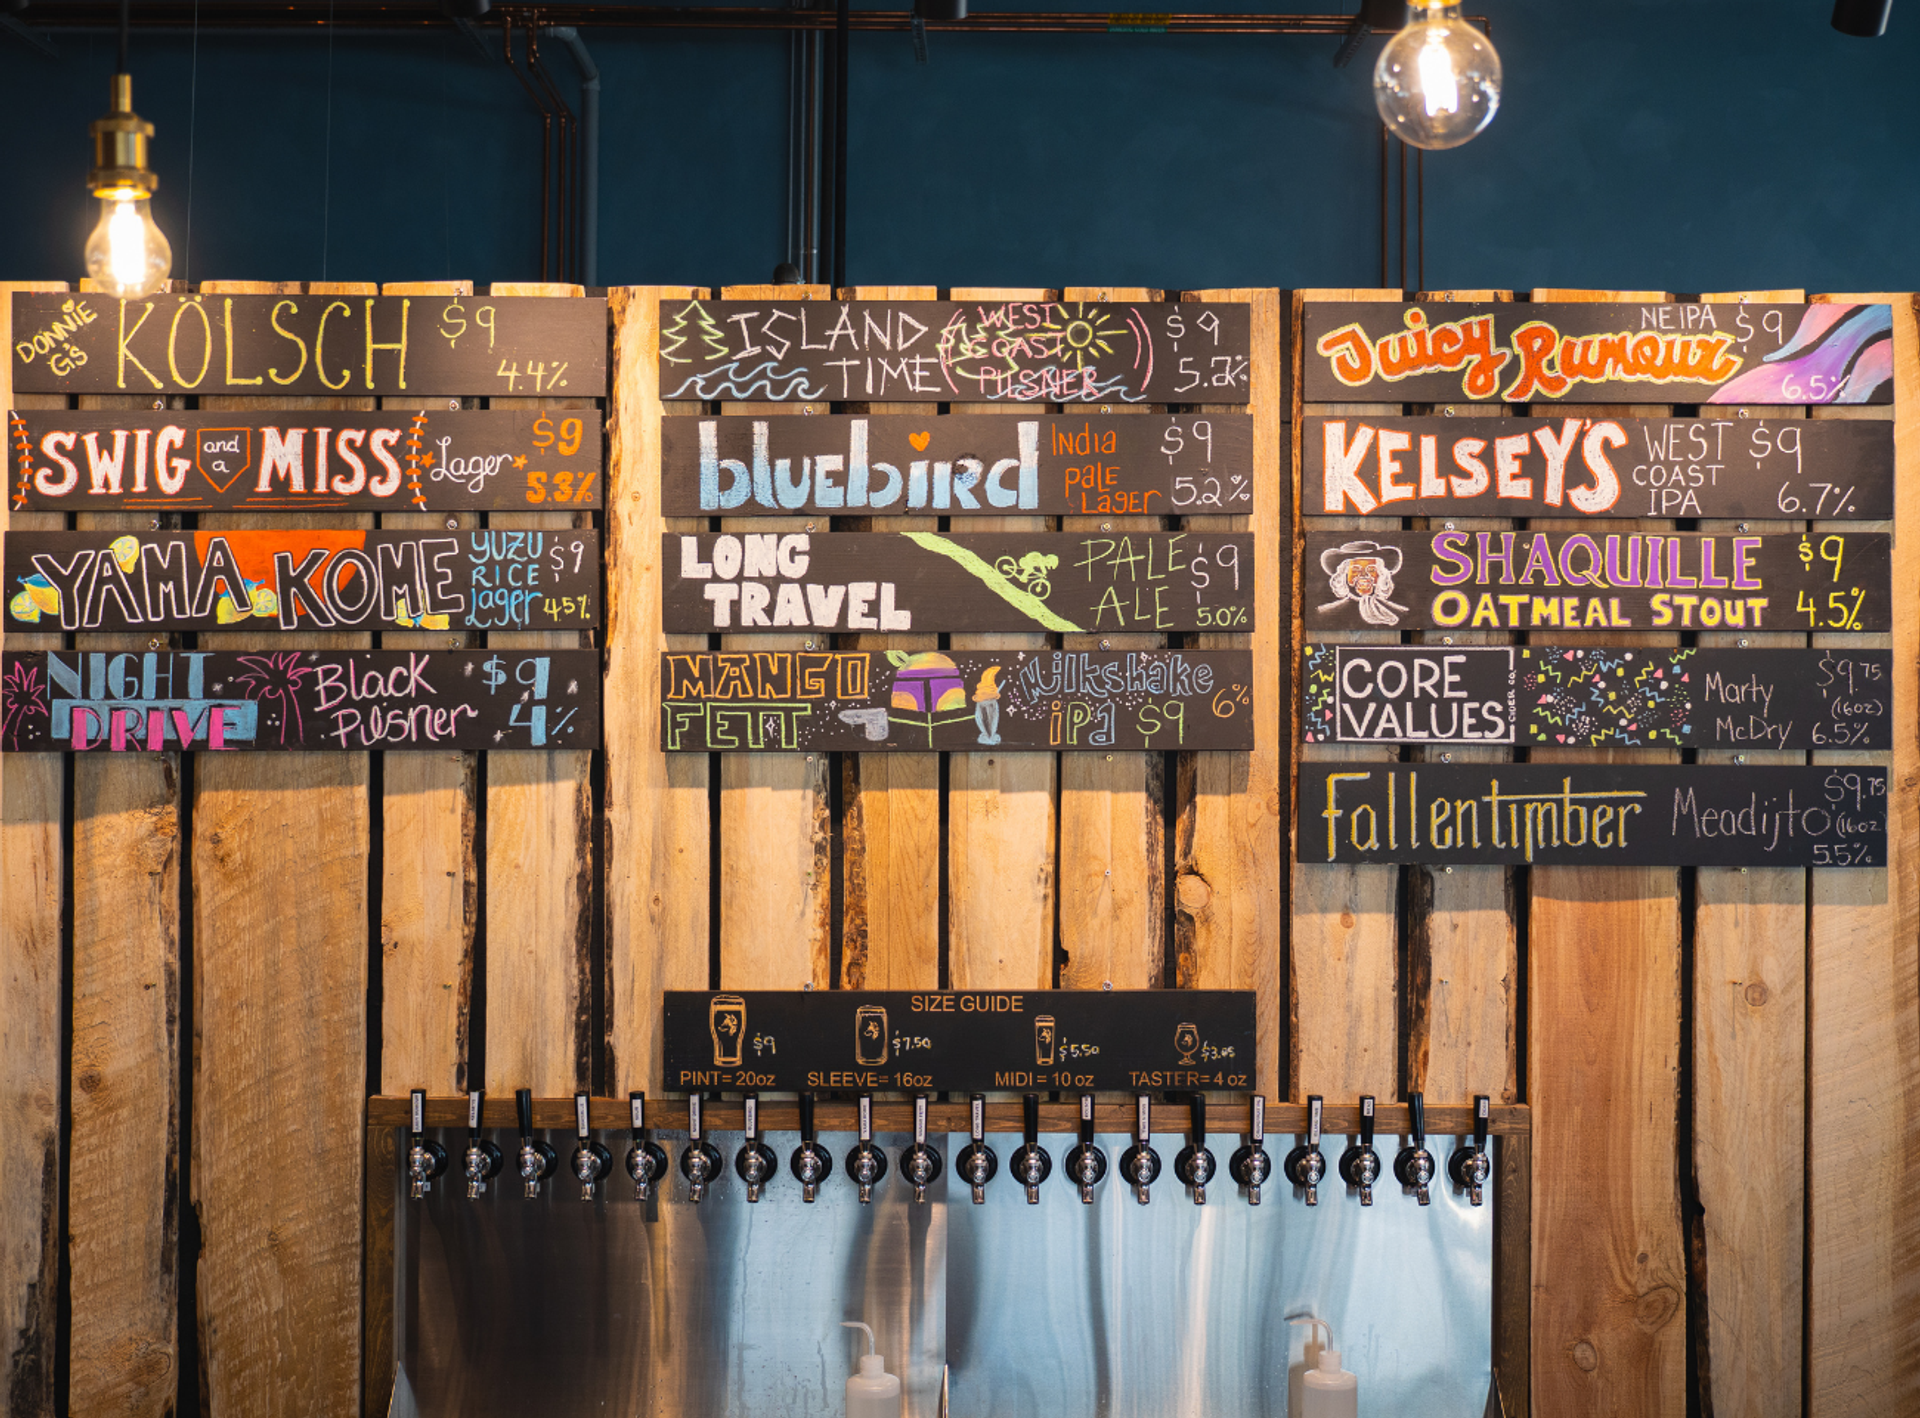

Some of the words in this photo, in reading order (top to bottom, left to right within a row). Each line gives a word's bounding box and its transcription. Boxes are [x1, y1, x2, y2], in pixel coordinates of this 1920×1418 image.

[16, 299, 97, 363] DONNIE
[117, 295, 410, 389] KÖLSCH
[440, 297, 495, 348] $9
[727, 303, 928, 360] ISLAND
[967, 331, 1067, 359] COAST
[1166, 305, 1220, 353] $9
[1736, 304, 1783, 353] $9
[497, 359, 568, 392] 4.4%
[822, 354, 942, 399] TIME
[1317, 307, 1513, 400] Juicy
[1501, 320, 1744, 402] Rumour
[1781, 374, 1851, 401] 6.5%
[203, 435, 240, 454] and
[532, 411, 583, 456] $9
[1160, 416, 1212, 465] $9
[1643, 422, 1734, 463] WEST
[1749, 420, 1802, 474] $9
[34, 425, 192, 496] SWIG
[212, 460, 230, 473] a
[254, 427, 403, 497] MISS
[430, 436, 513, 493] Lager
[1323, 418, 1630, 515] KELSEY'S
[1632, 464, 1726, 487] COAST
[526, 471, 597, 504] 5.3%
[1171, 474, 1250, 507] 5.2%
[1647, 488, 1703, 517] IPA
[1777, 482, 1856, 517] 6.7%
[471, 564, 540, 587] RICE
[549, 535, 584, 583] $9
[680, 533, 811, 580] LONG
[1073, 533, 1188, 582] PALE
[1190, 542, 1240, 605] $9
[1430, 531, 1762, 590] SHAQUILLE
[1798, 534, 1844, 582] $9
[31, 537, 252, 630] YAMA
[274, 539, 465, 630] KOME
[703, 581, 912, 632] TRAVEL
[1089, 585, 1175, 630] ALE
[1196, 605, 1248, 628] 5.0%
[1431, 590, 1633, 628] OATMEAL
[1796, 587, 1866, 631] 4.5%
[47, 651, 215, 700] NIGHT
[482, 655, 550, 700] $9
[666, 652, 871, 699] MANGO
[1019, 651, 1215, 705] Milkshake
[1342, 655, 1469, 700] CORE
[1705, 672, 1773, 718] Marty
[1135, 697, 1185, 748] $9
[1212, 683, 1250, 718] 6%
[1341, 701, 1506, 739] VALUES
[70, 704, 242, 751] DRIVE
[329, 702, 478, 748] Pilsner
[508, 704, 578, 746] 4%
[662, 702, 812, 750] FETT
[1716, 715, 1793, 750] McDry
[1812, 722, 1870, 745] 6.5%
[911, 995, 955, 1012] SIZE
[960, 995, 1024, 1012] GUIDE
[753, 1033, 776, 1056] $9
[735, 1071, 776, 1086] 20oz
[894, 1072, 933, 1087] 16oz
[995, 1072, 1033, 1087] MIDI
